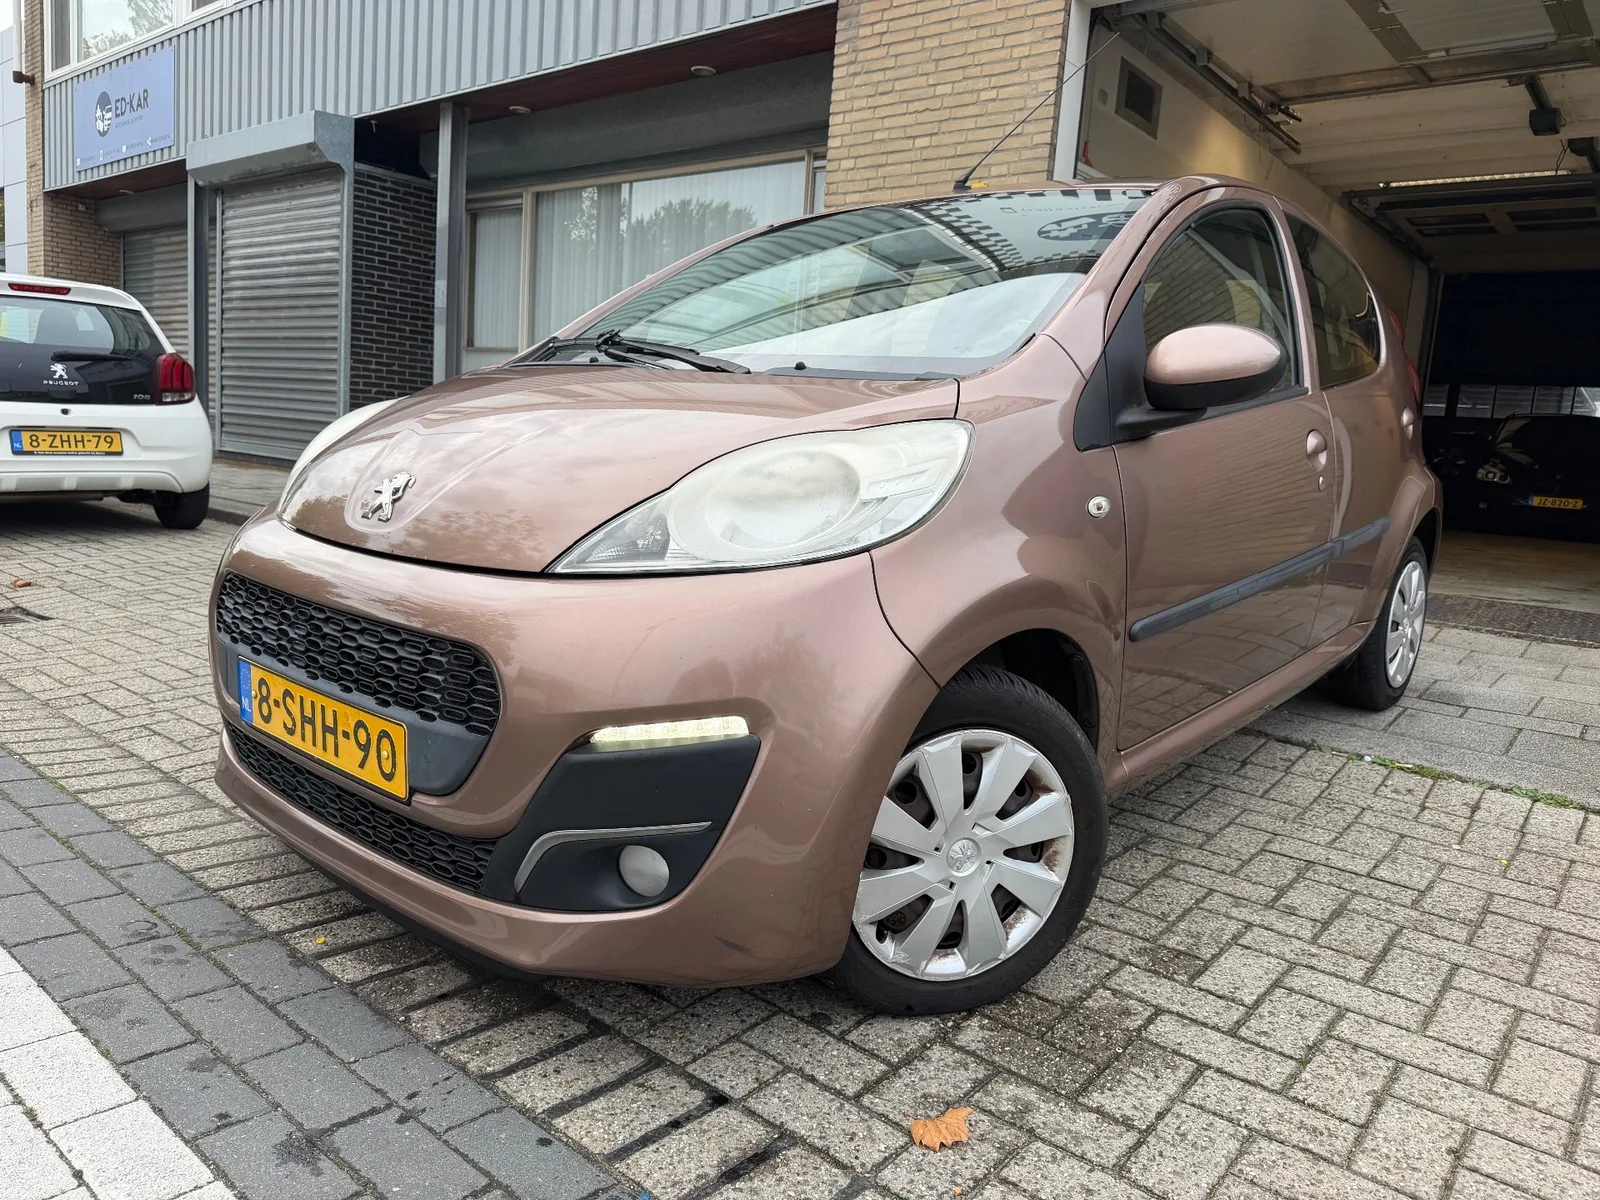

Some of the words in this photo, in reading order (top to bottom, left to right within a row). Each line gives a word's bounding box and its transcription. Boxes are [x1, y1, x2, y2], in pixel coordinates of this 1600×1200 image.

[114, 88, 149, 118] ED-KAR
[29, 434, 114, 449] 8-ZHH-79
[1538, 498, 1579, 508] JZ-820-Z
[241, 696, 252, 713] NL
[258, 677, 397, 782] 8-SHH-90
